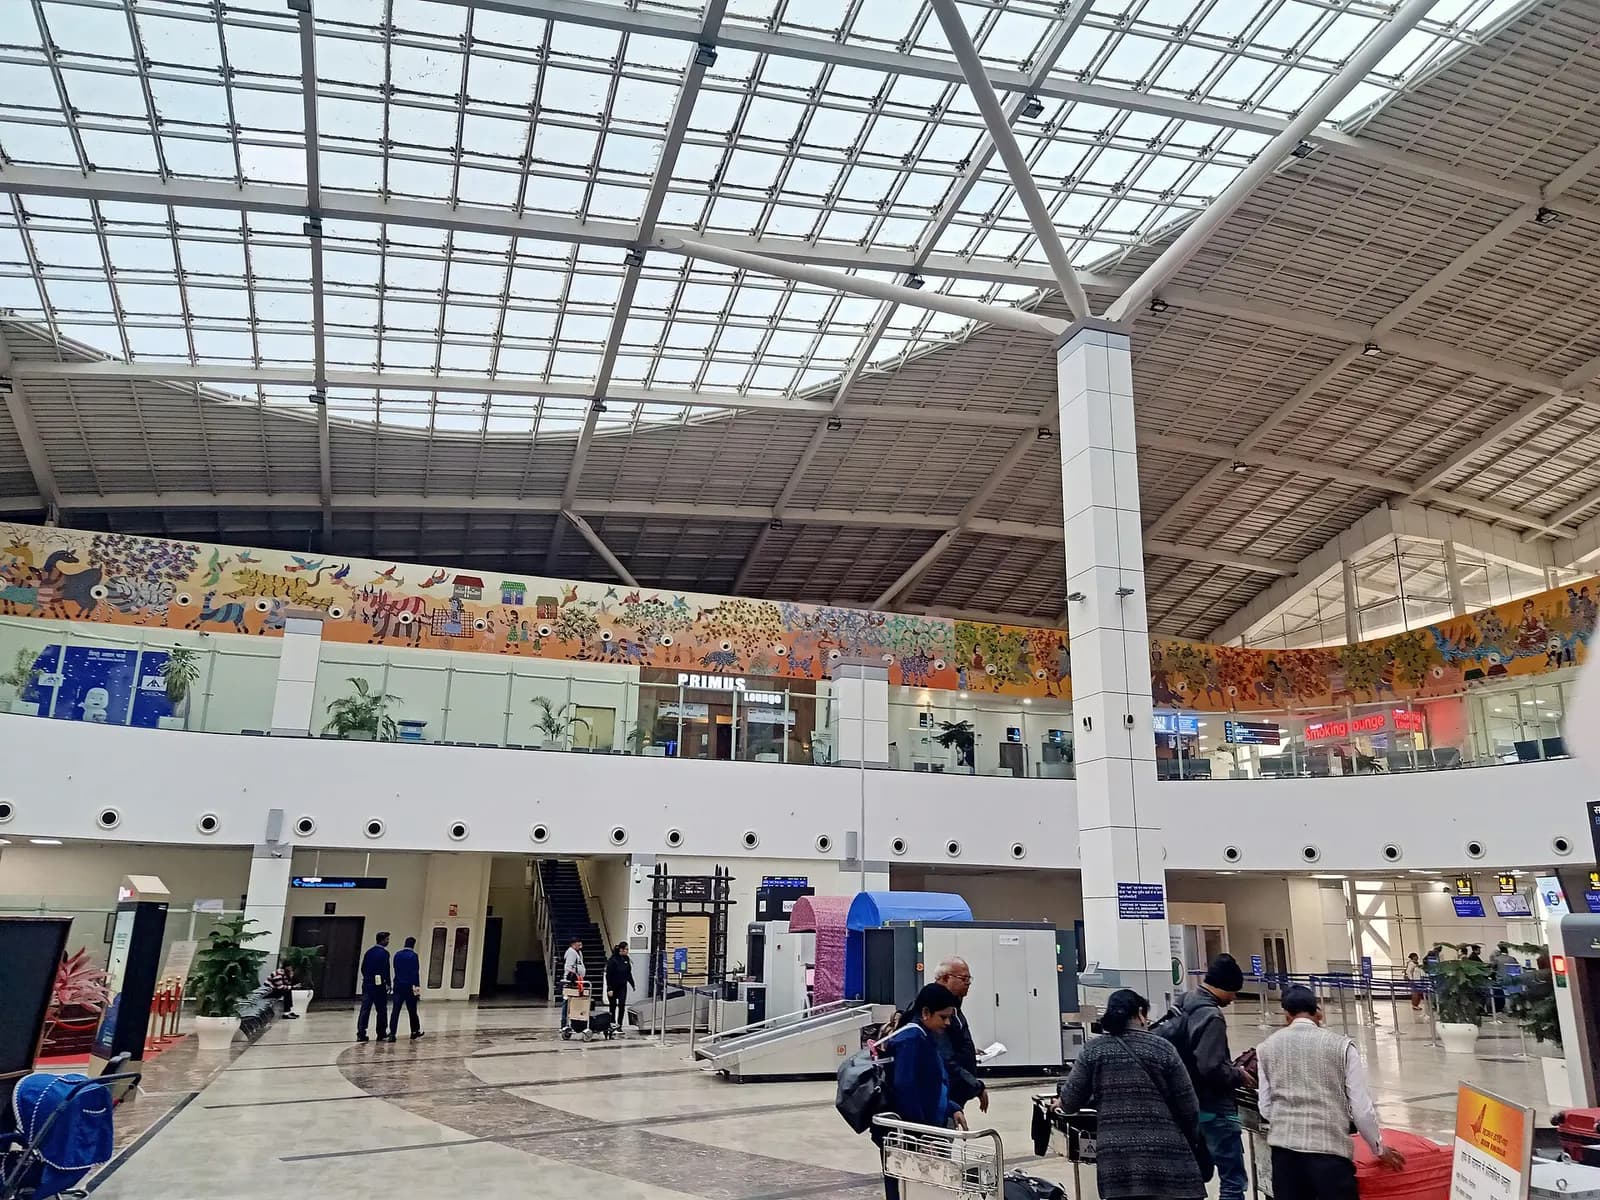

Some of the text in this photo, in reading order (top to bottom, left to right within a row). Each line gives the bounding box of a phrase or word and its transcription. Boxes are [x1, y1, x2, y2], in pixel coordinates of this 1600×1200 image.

[678, 673, 746, 691] PRIMUS
[743, 692, 781, 704] Lounge
[1305, 714, 1384, 740] Smoking ounge
